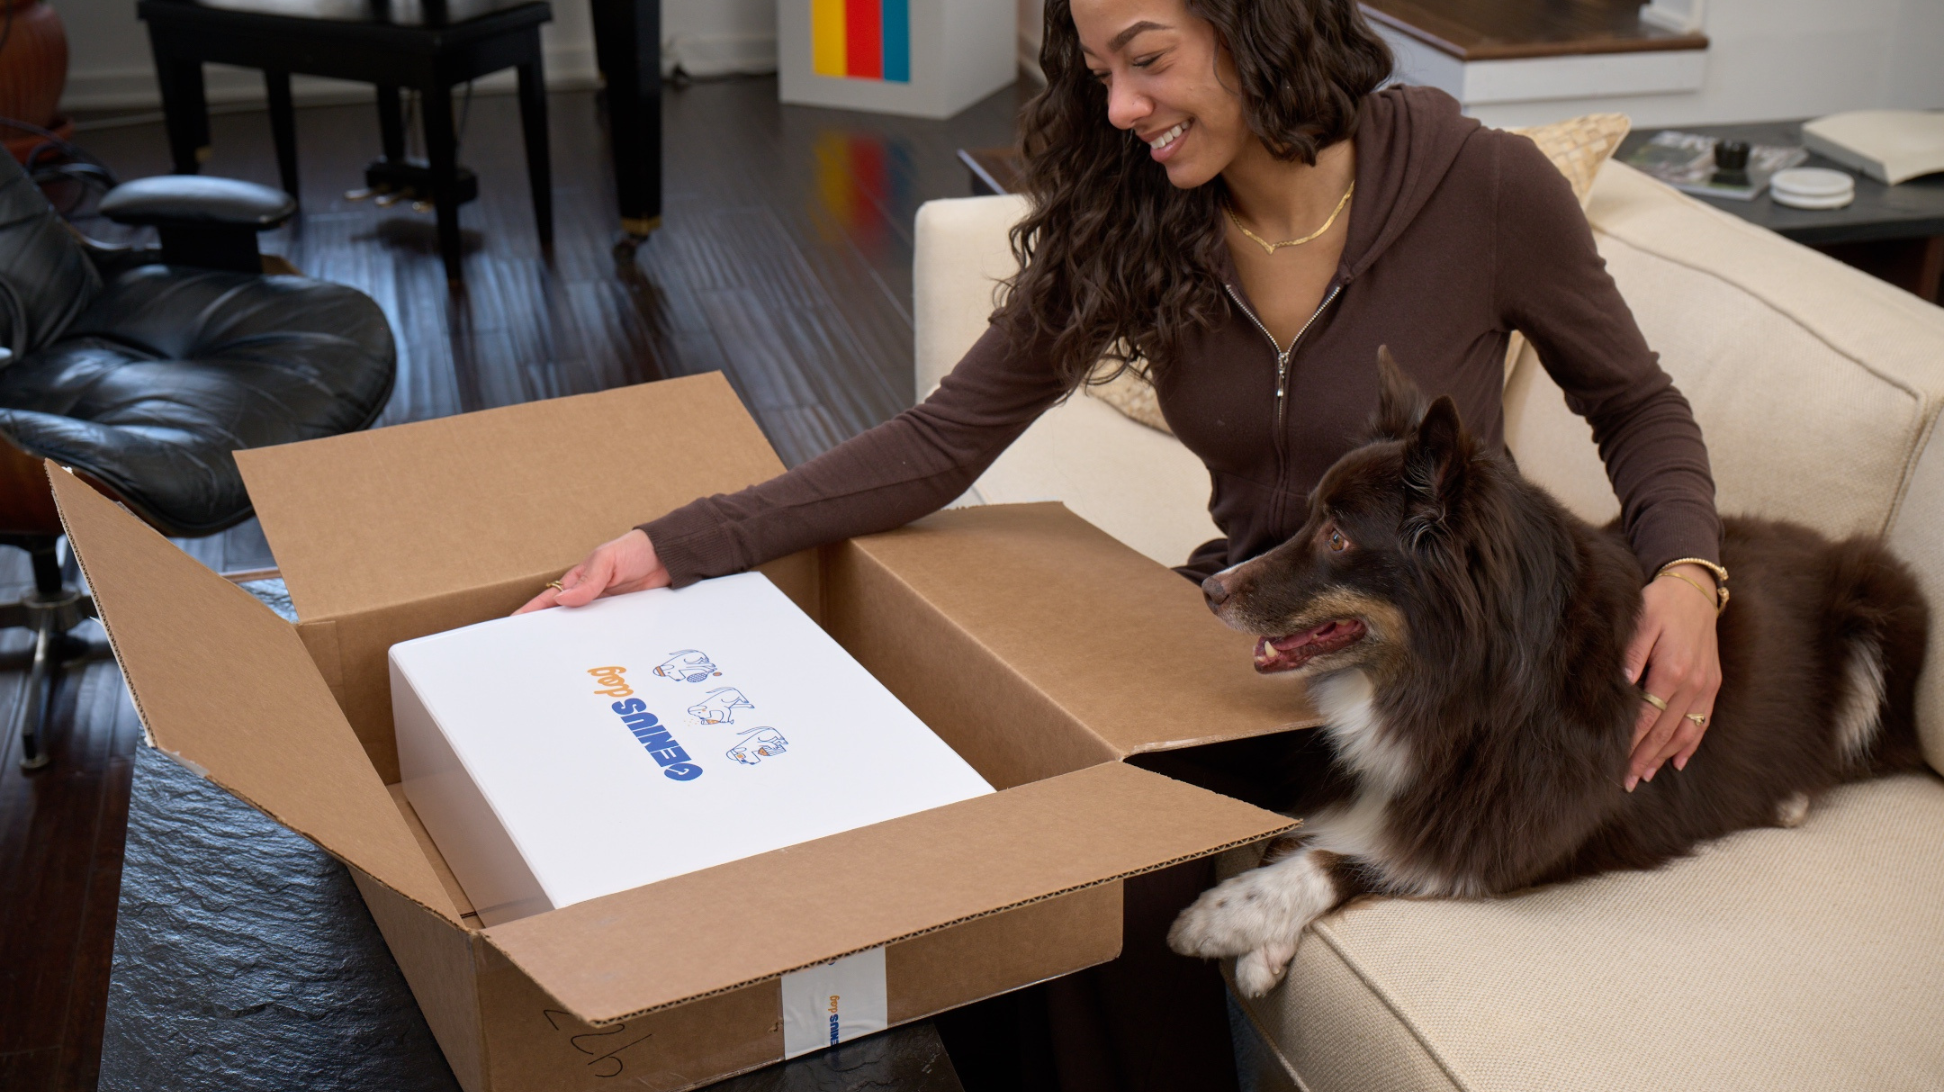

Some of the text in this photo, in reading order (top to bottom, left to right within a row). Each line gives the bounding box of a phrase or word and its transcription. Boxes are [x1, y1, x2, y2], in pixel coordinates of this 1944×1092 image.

[587, 666, 703, 781] GENIUS dog
[828, 995, 840, 1046] ENIUS dog
